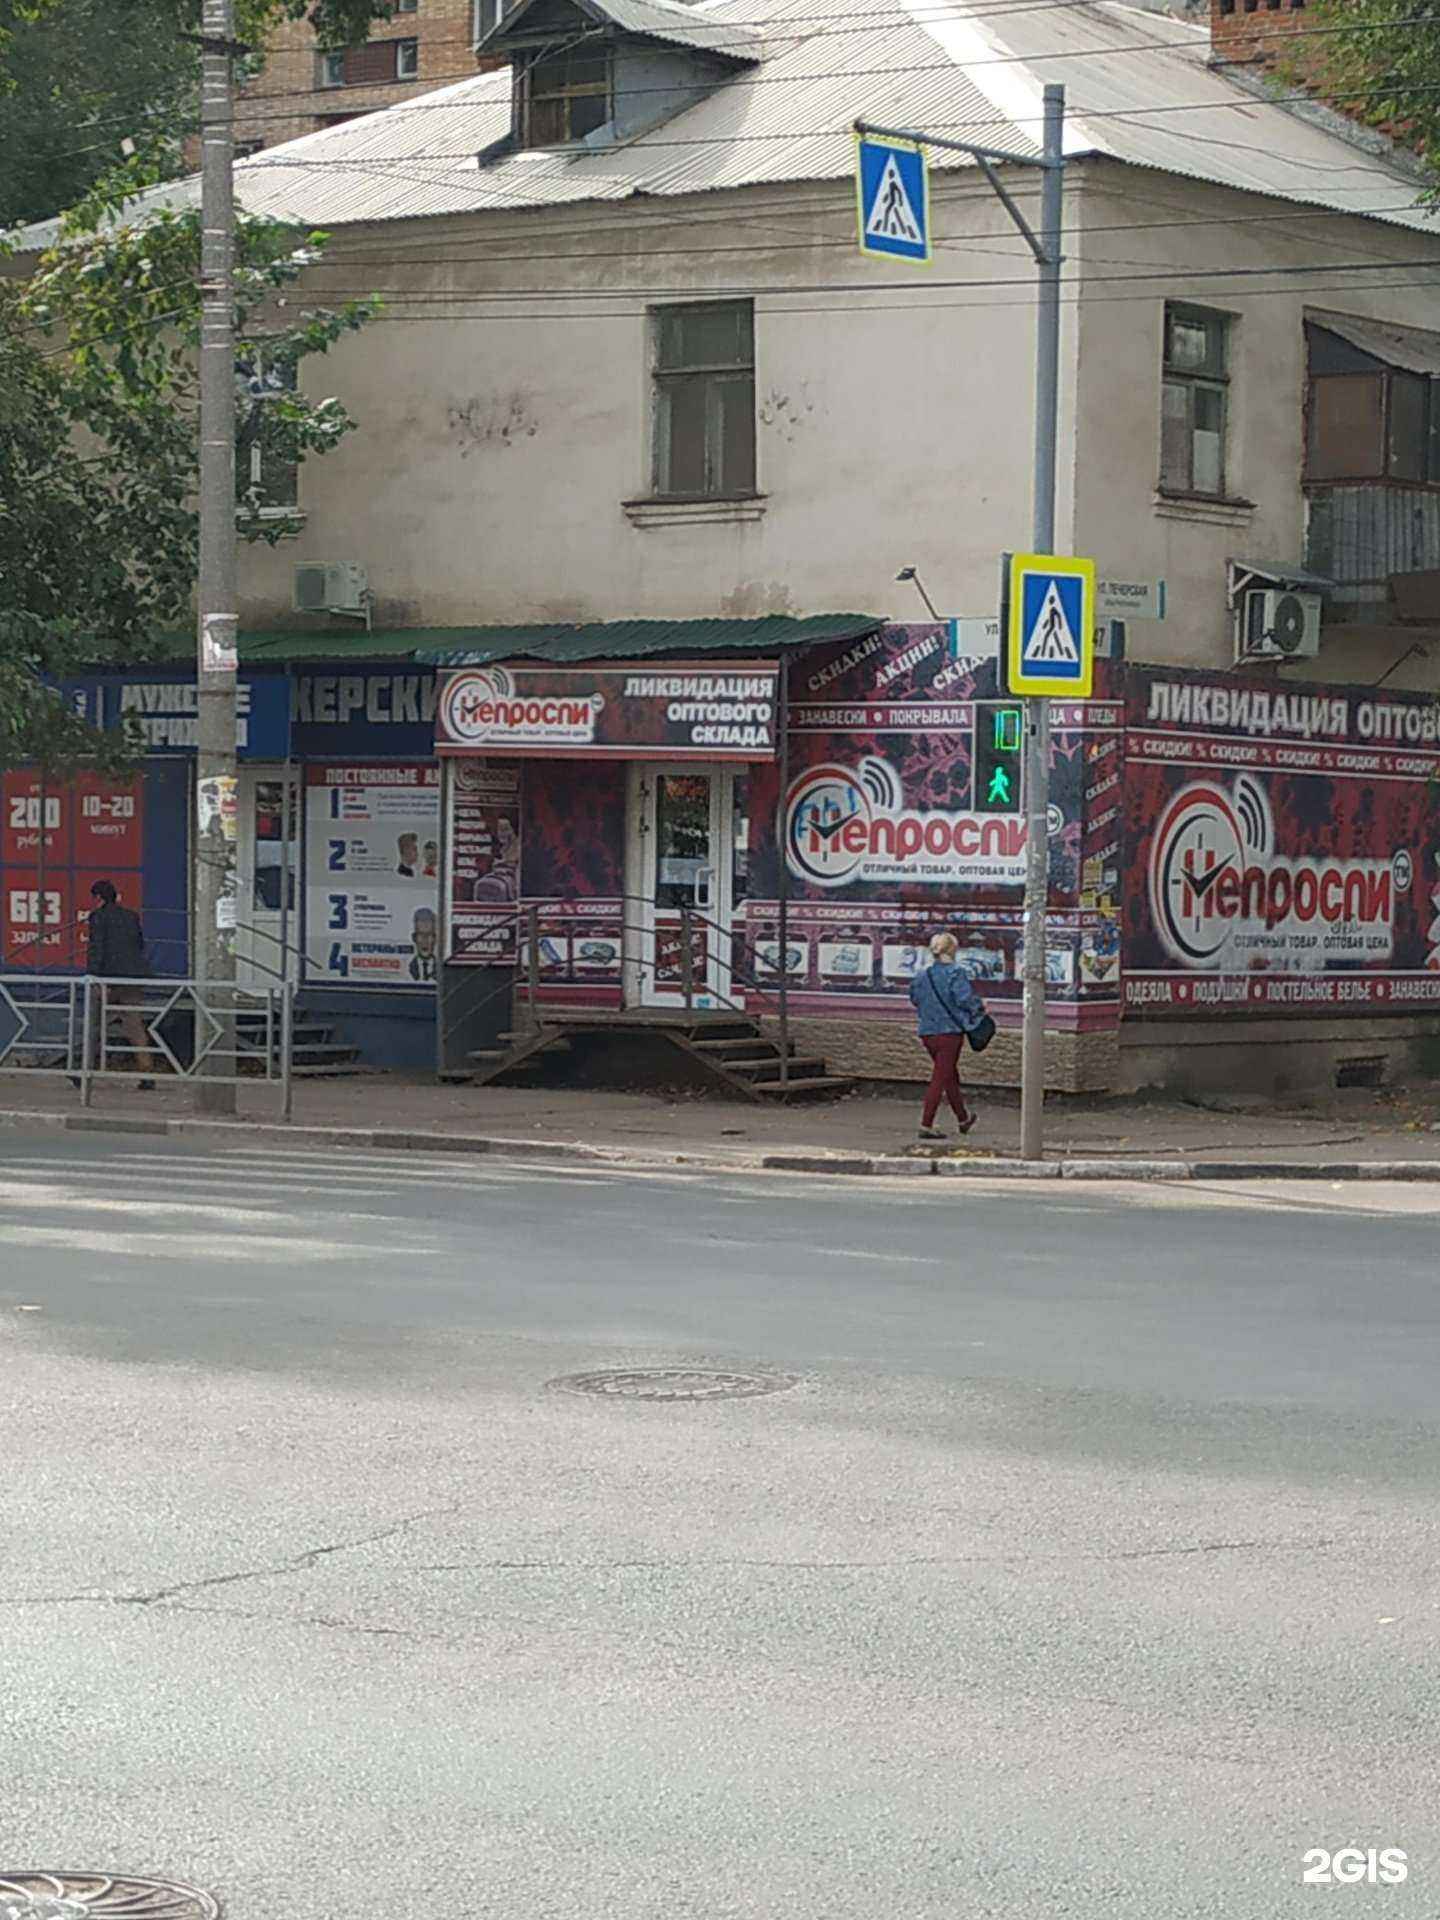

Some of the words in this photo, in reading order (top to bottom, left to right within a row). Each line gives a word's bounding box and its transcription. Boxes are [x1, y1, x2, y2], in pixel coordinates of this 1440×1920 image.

[624, 677, 774, 699] ЛИКВИДАЦИЯ
[667, 702, 772, 722] ОПТОВОГО
[889, 709, 968, 725] ПОКРЫВАЛА
[1147, 681, 1349, 738] ЛИКВИДАЦИЯ
[1357, 701, 1440, 742] ОПТОВ
[690, 724, 770, 746] СКЛАДА
[9, 797, 61, 829] 200
[82, 796, 135, 818] 10-20
[328, 840, 346, 871] 2
[1181, 847, 1391, 931] Непроспи
[328, 894, 348, 929] 3
[329, 942, 348, 977] 4
[1126, 981, 1173, 1005] ОДЕЯЛА
